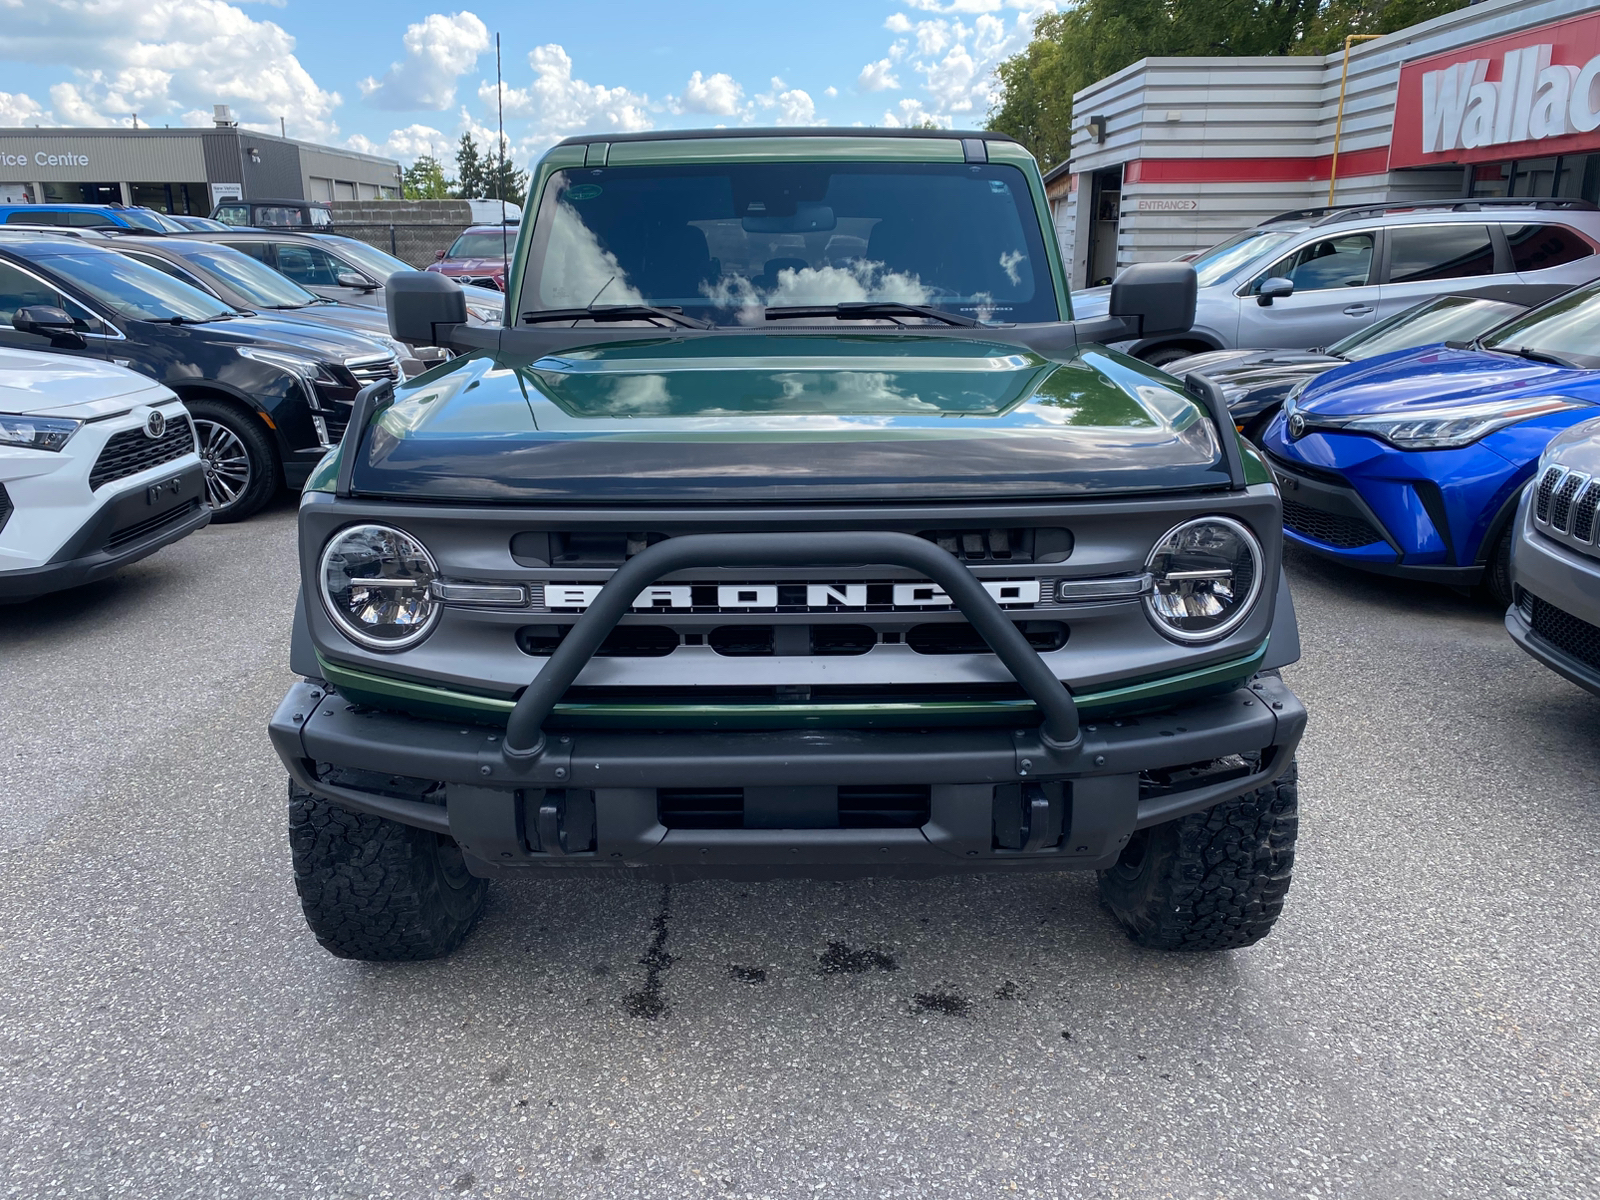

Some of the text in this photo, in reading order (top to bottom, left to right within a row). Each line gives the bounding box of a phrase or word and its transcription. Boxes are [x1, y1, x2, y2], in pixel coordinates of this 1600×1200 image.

[0, 151, 89, 166] ice Centre
[1138, 200, 1190, 210] ENTRANCE
[544, 581, 1040, 607] BRONCO
